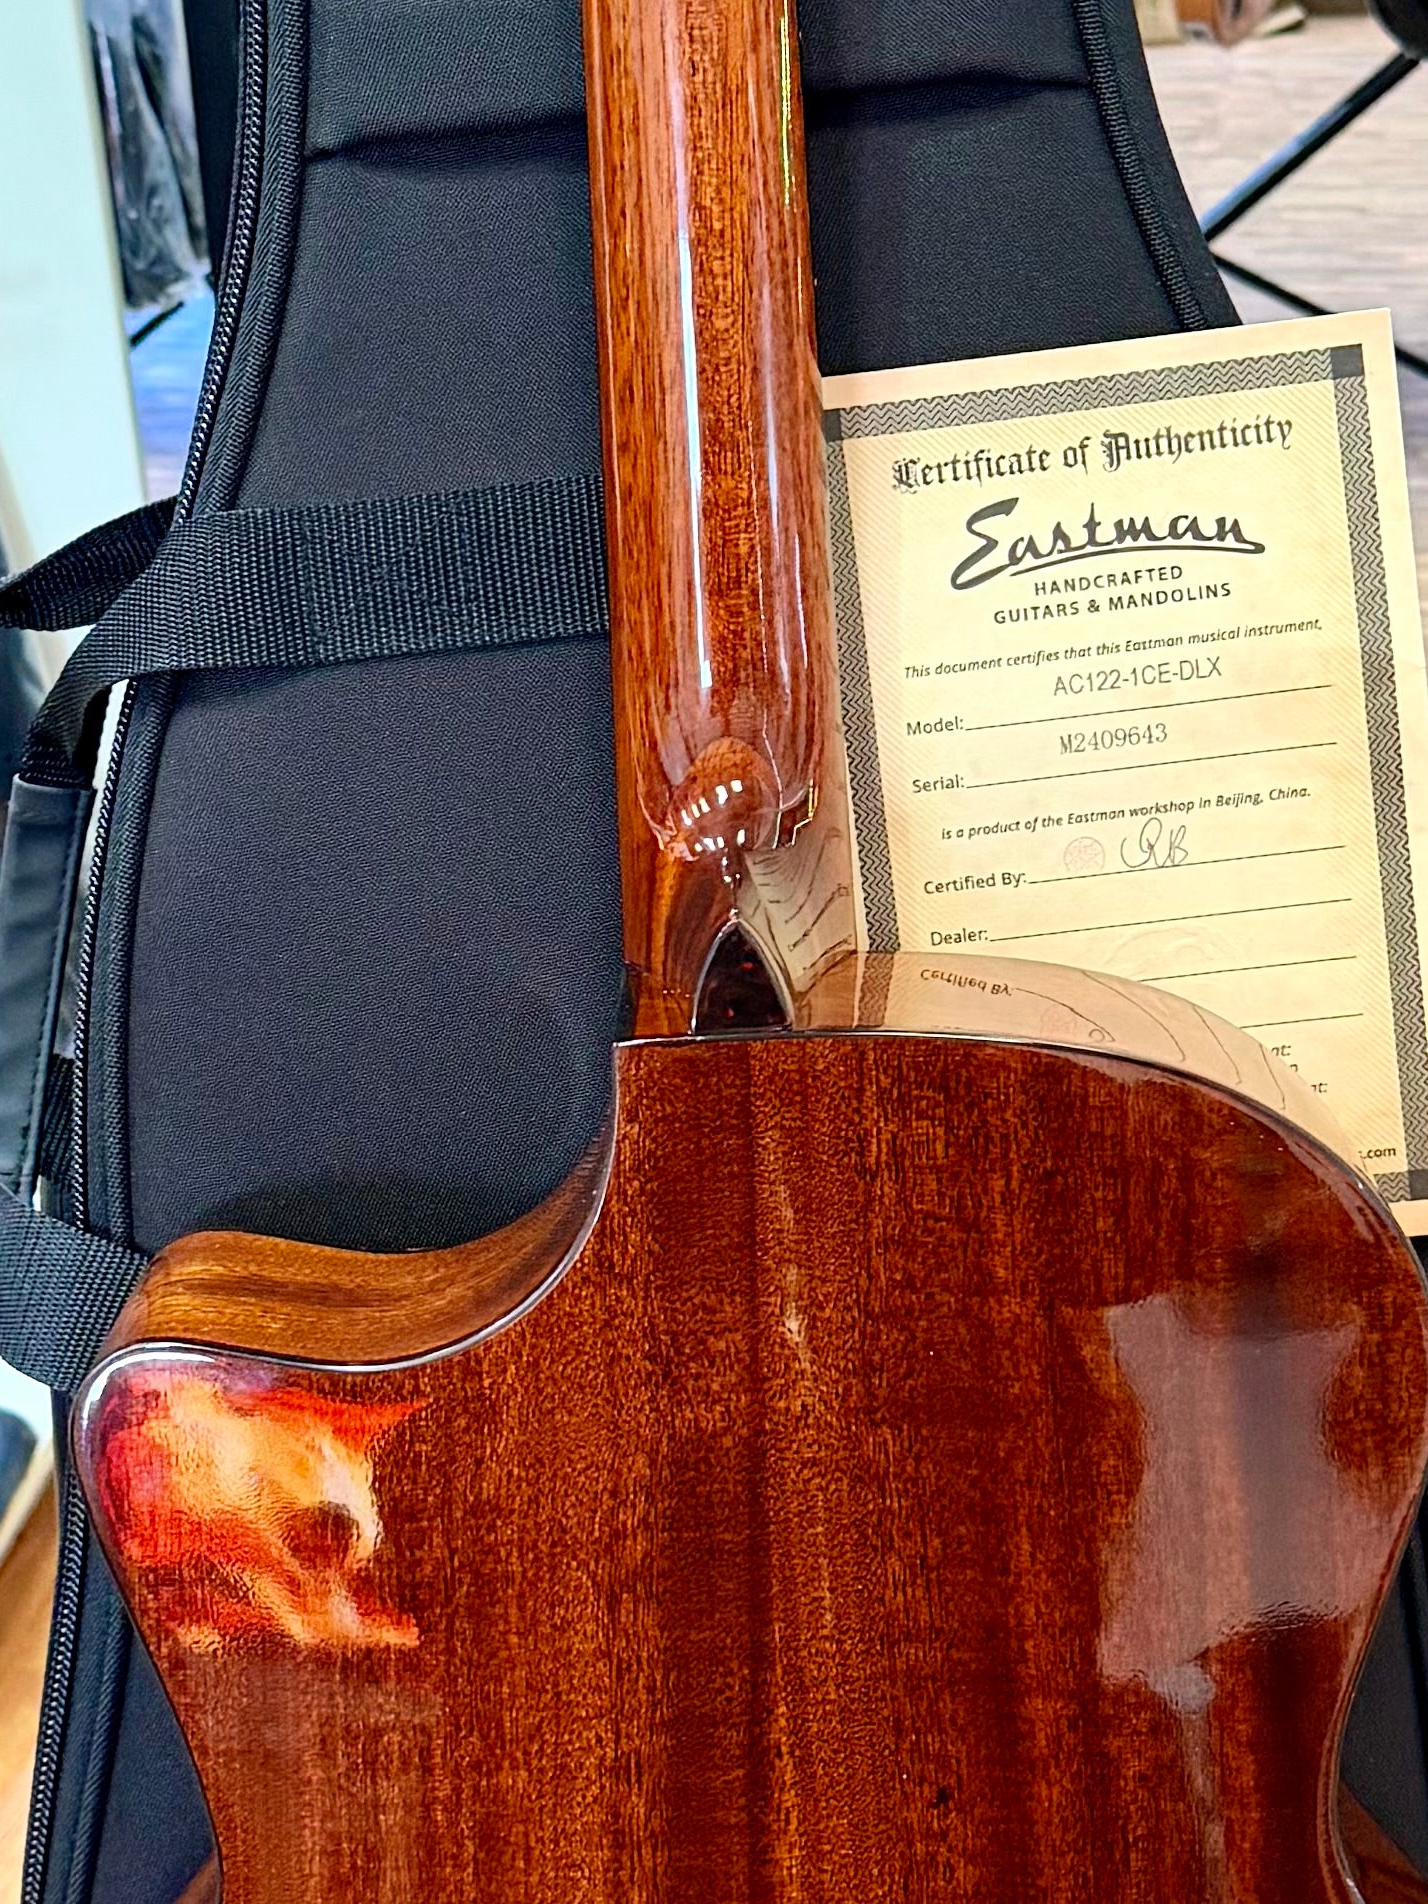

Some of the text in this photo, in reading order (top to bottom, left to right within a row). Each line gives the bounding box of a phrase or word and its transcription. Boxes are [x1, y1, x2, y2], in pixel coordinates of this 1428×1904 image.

[892, 414, 1293, 494] Certificate of Authenticity
[950, 496, 1265, 591] Eastman
[1034, 565, 1183, 596] HANDCRAFTED
[993, 582, 1232, 625] GUITARS & MANDOLINS
[904, 665, 931, 679] This
[934, 657, 1002, 675] document
[1006, 650, 1060, 667] certifies
[1063, 647, 1092, 660] that
[1096, 641, 1121, 656] this
[1124, 636, 1184, 653] Eastman
[1188, 626, 1240, 645] musical
[1053, 656, 1222, 697] AC122-1CE-DLX
[906, 715, 964, 736] Model:
[1059, 722, 1168, 756] M2409643
[912, 774, 965, 794] Serial:
[941, 827, 952, 840] is
[956, 828, 964, 839] a
[968, 820, 1021, 839] product
[1024, 816, 1039, 833] of
[1042, 815, 1064, 828] the
[1067, 808, 1126, 826] Eastman
[1129, 800, 1195, 817] workshop
[1198, 796, 1212, 809] in
[1268, 785, 1312, 802] China.
[924, 871, 1027, 895] Certified By:
[930, 927, 989, 946] Dealer:
